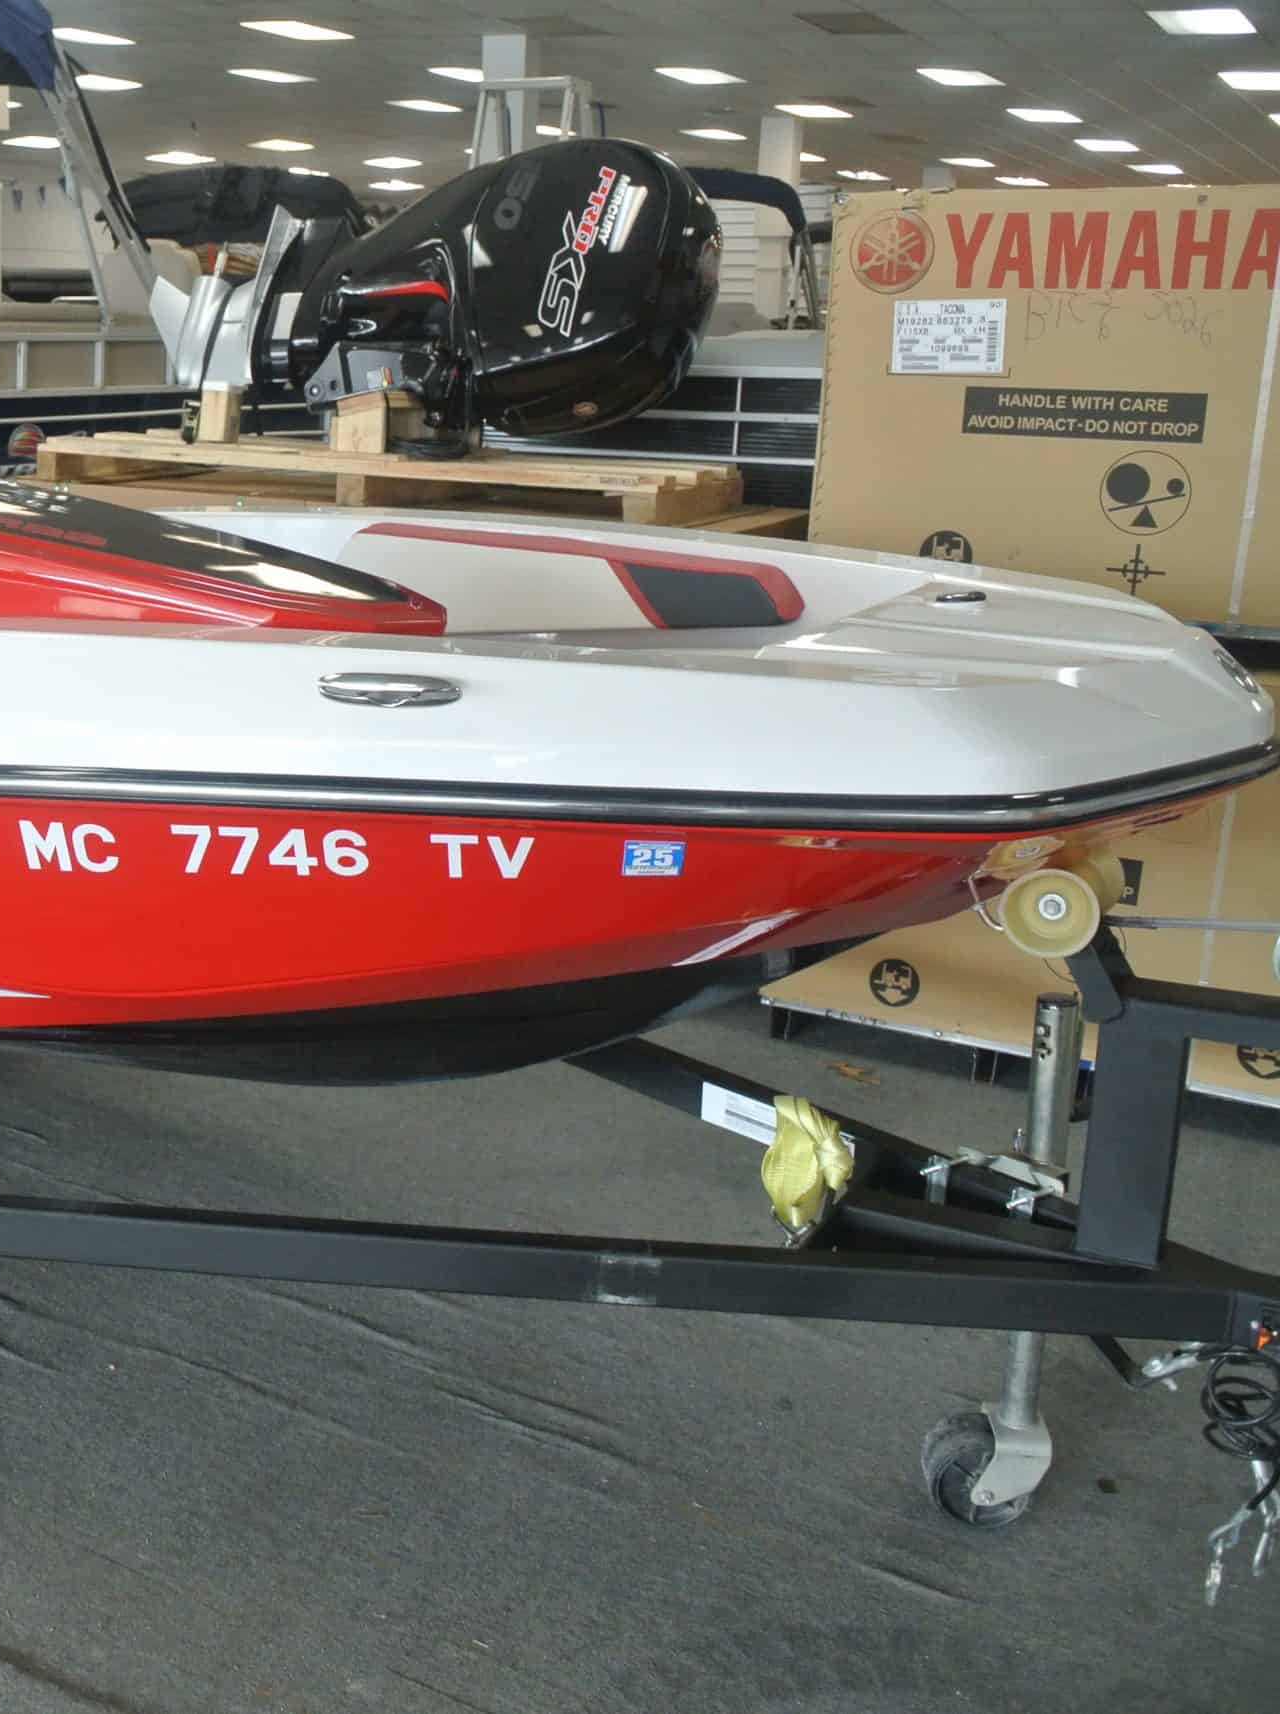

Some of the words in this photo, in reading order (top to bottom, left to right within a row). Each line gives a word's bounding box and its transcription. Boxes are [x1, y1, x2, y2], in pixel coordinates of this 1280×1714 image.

[572, 165, 617, 255] PRO
[599, 173, 631, 247] MERCURY
[538, 210, 586, 338] XS
[945, 208, 1280, 290] YAMAHA
[968, 414, 1014, 429] AVOID
[1113, 420, 1148, 434] NOT
[1150, 422, 1199, 437] DROP
[998, 393, 1067, 409] HANDLE
[1072, 395, 1114, 411] WITH
[1119, 398, 1169, 413] CARE
[19, 820, 120, 873] MC
[170, 824, 369, 877] 7746
[430, 833, 535, 879] TV
[631, 848, 674, 866] 25
